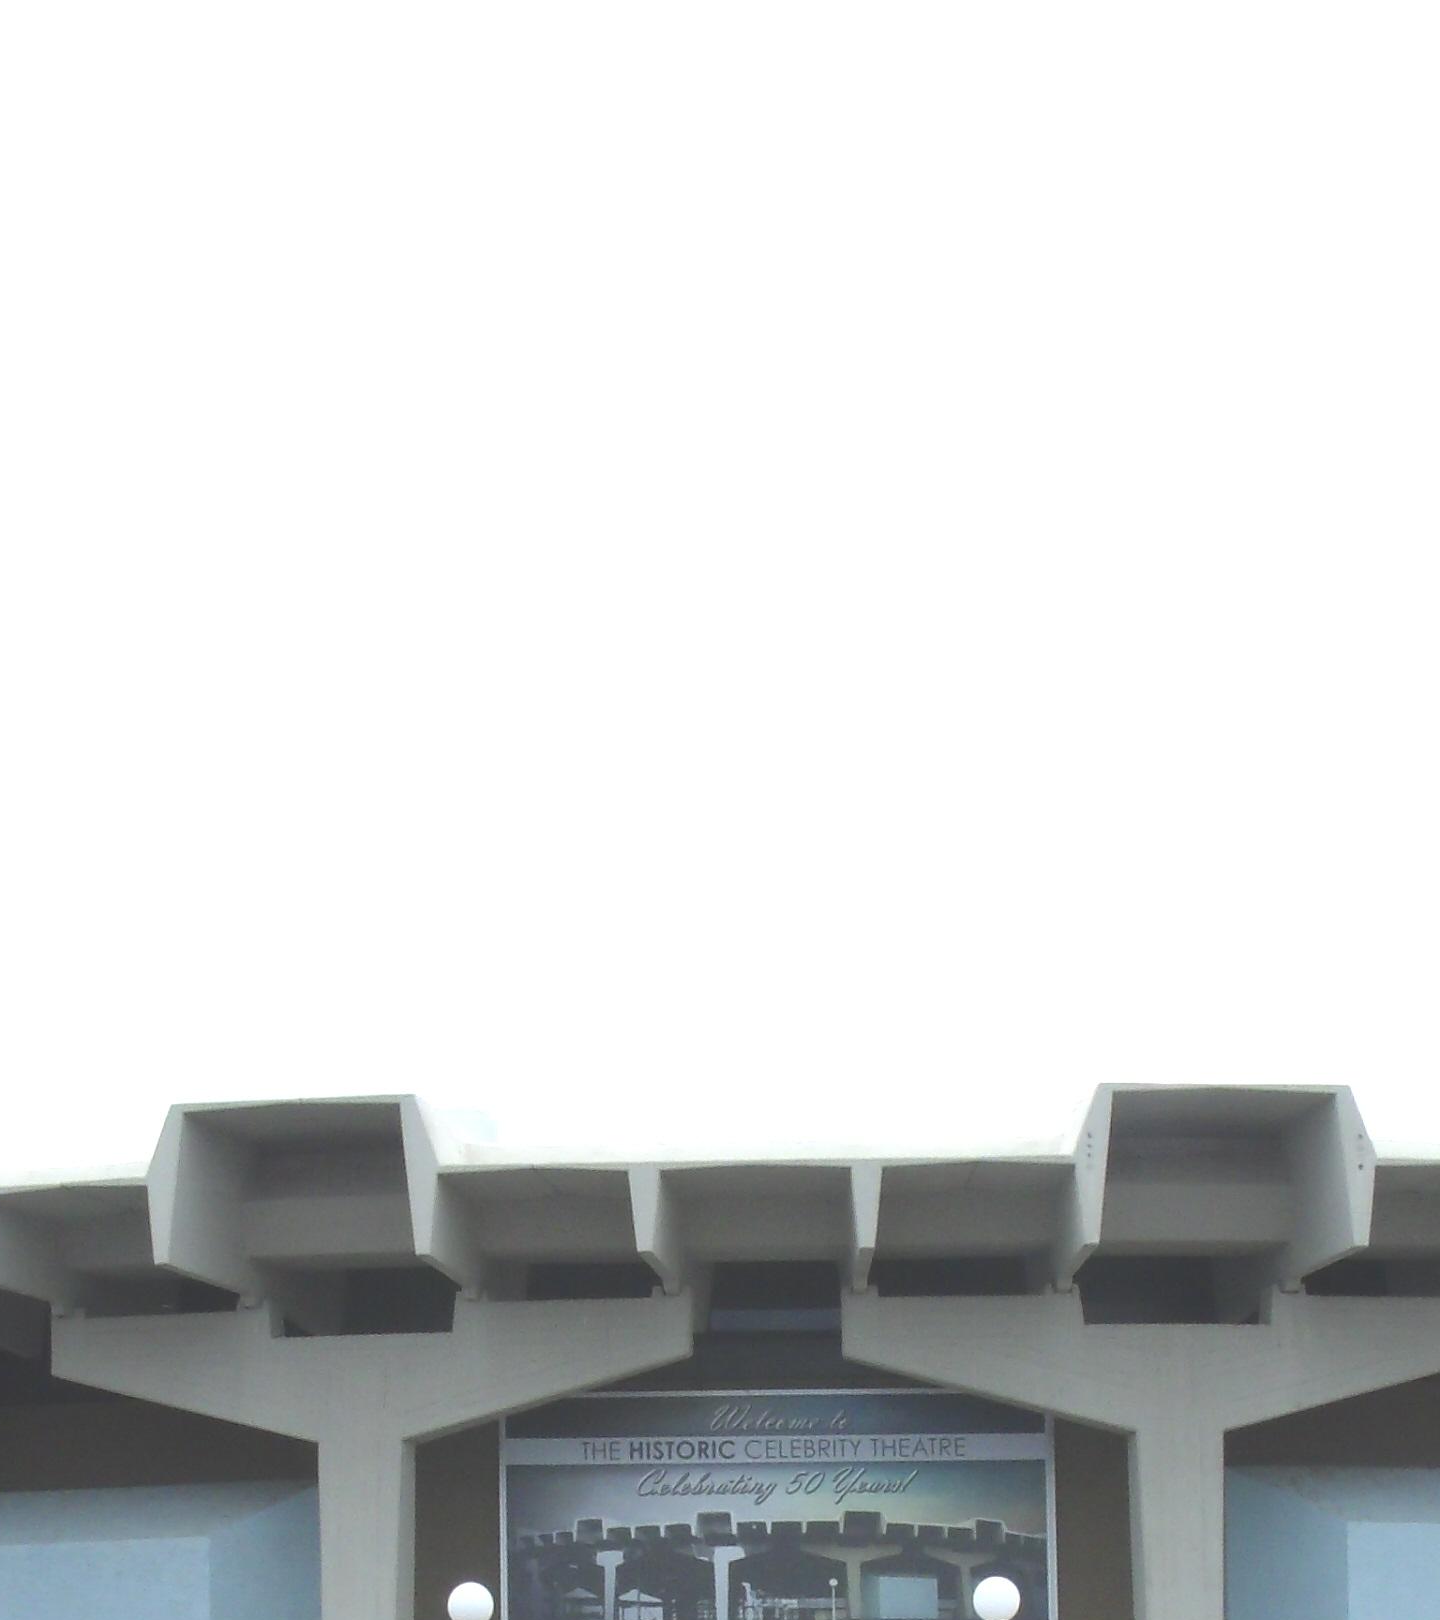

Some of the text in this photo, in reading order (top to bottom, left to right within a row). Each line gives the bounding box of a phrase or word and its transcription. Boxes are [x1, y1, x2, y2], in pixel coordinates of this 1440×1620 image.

[711, 1404, 847, 1431] Welcome to
[582, 1437, 967, 1461] THE HISTORIC CELEBRITY THEATRE
[637, 1466, 920, 1506] Celebrating 50 Years!
